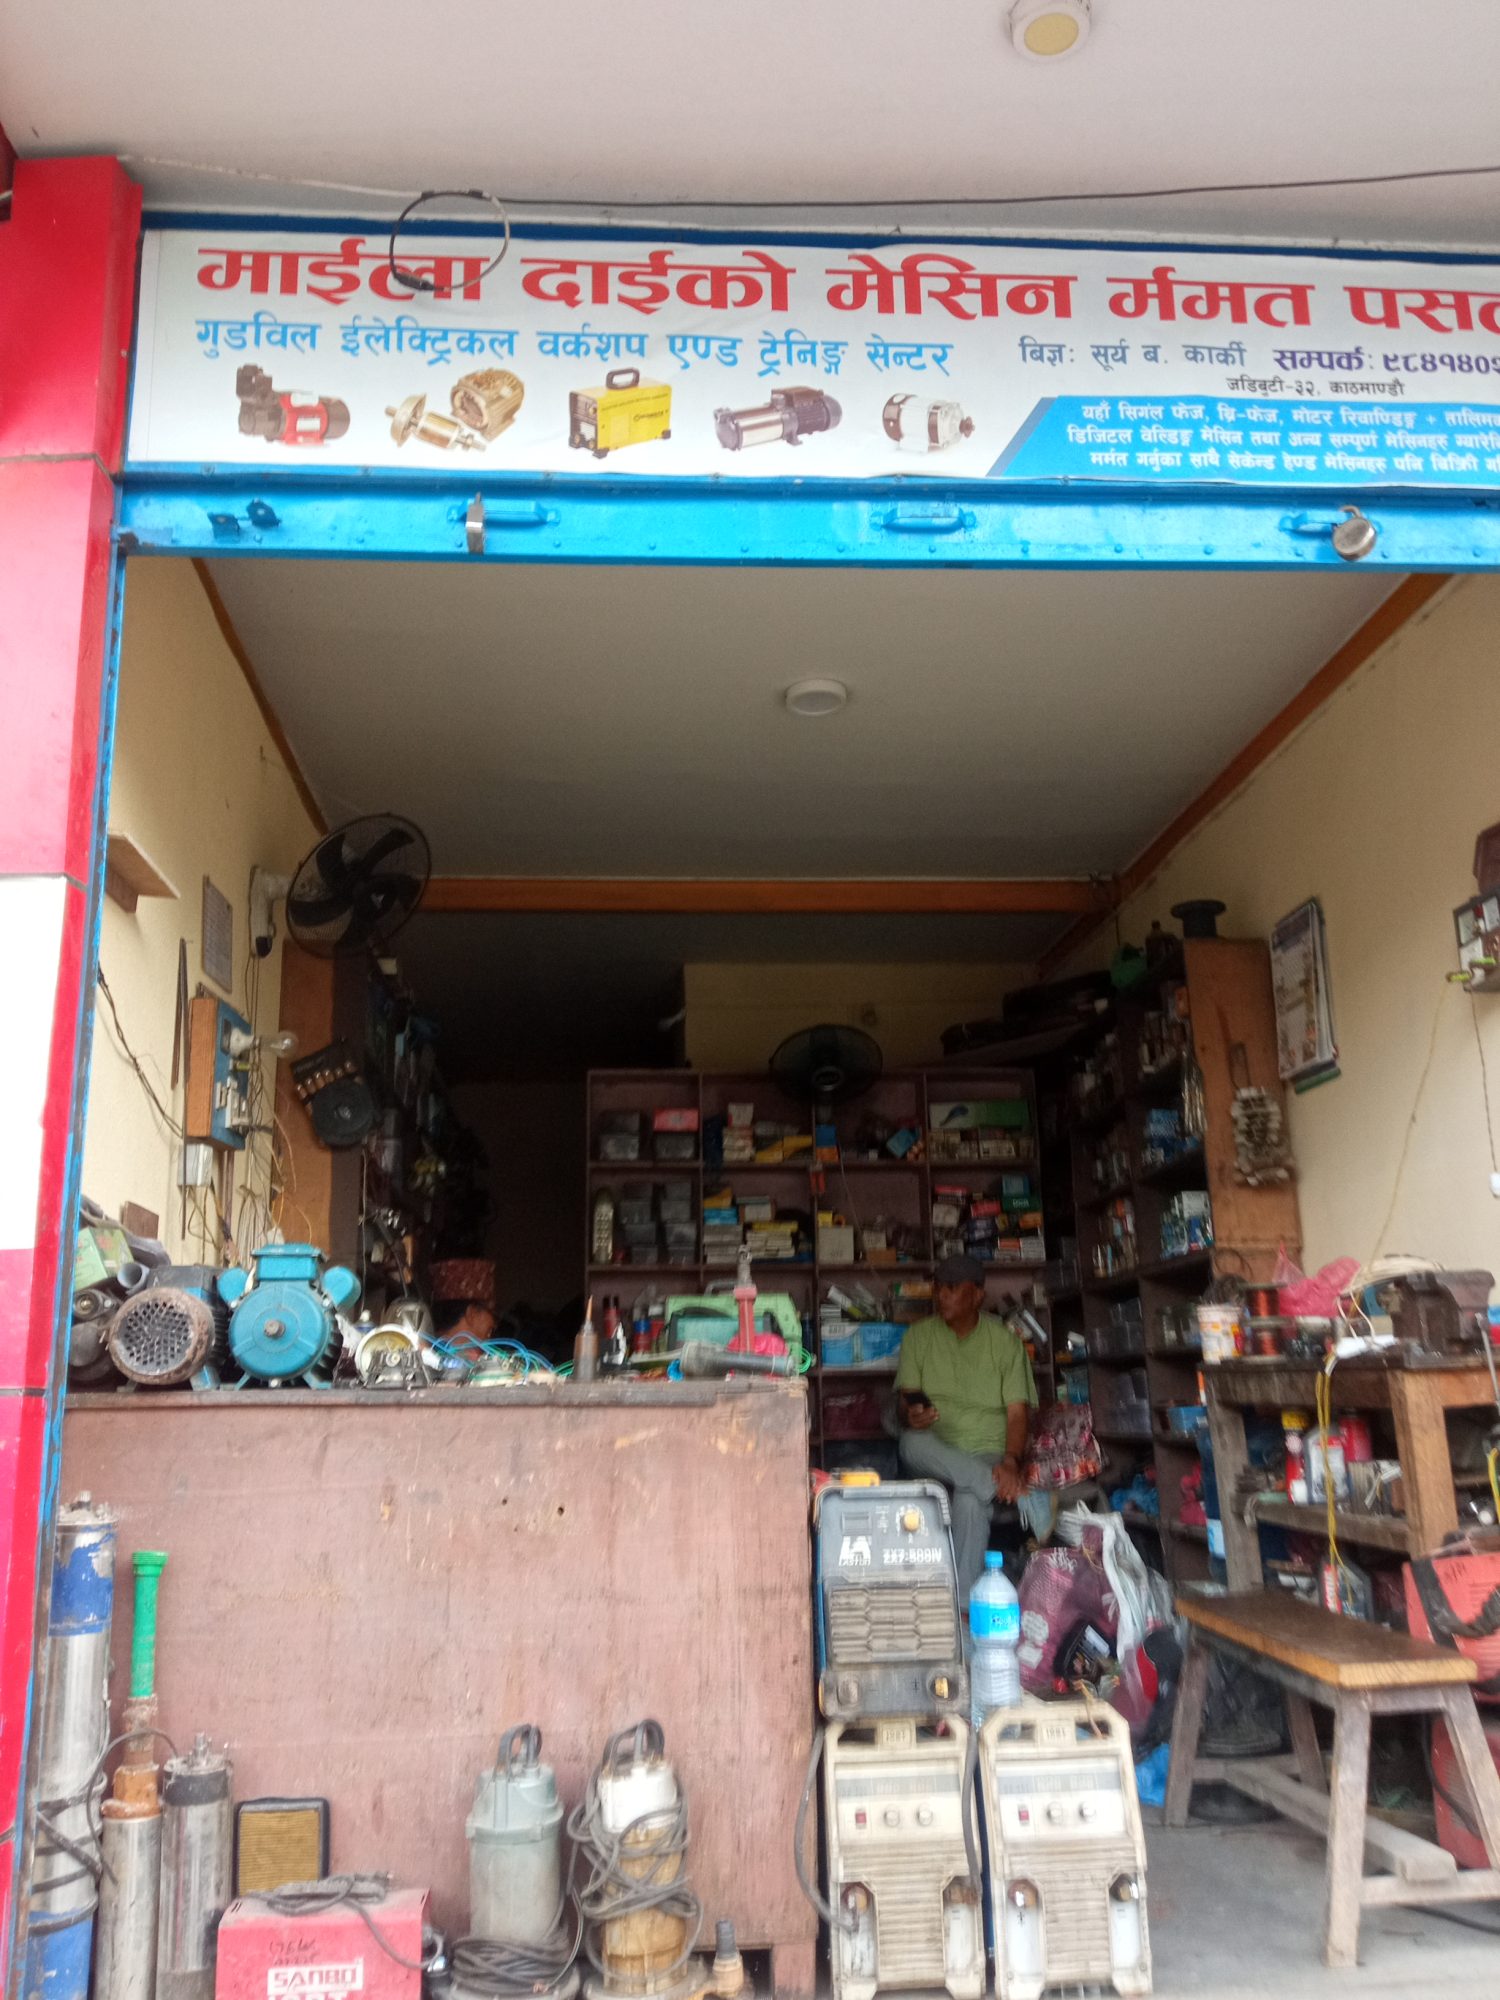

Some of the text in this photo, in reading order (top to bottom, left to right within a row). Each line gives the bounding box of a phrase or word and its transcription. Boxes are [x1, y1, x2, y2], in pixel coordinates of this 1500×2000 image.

[197, 237, 490, 306] माईला
[520, 250, 796, 315] दाईको
[826, 252, 1078, 321] मेसिन
[195, 310, 322, 360] गुडविल
[339, 315, 519, 367] ईलेक्ट्रिकल
[537, 322, 648, 362] वर्कशप
[668, 335, 744, 371] एण्ड
[864, 333, 954, 377] सेन्टर
[1090, 338, 1130, 371] सूर्य
[1182, 340, 1247, 367] कार्की
[1292, 406, 1334, 427] मोटर
[1067, 423, 1133, 445] डिजिटल
[1201, 425, 1244, 447] मेसिन
[1289, 432, 1322, 448] अन्य
